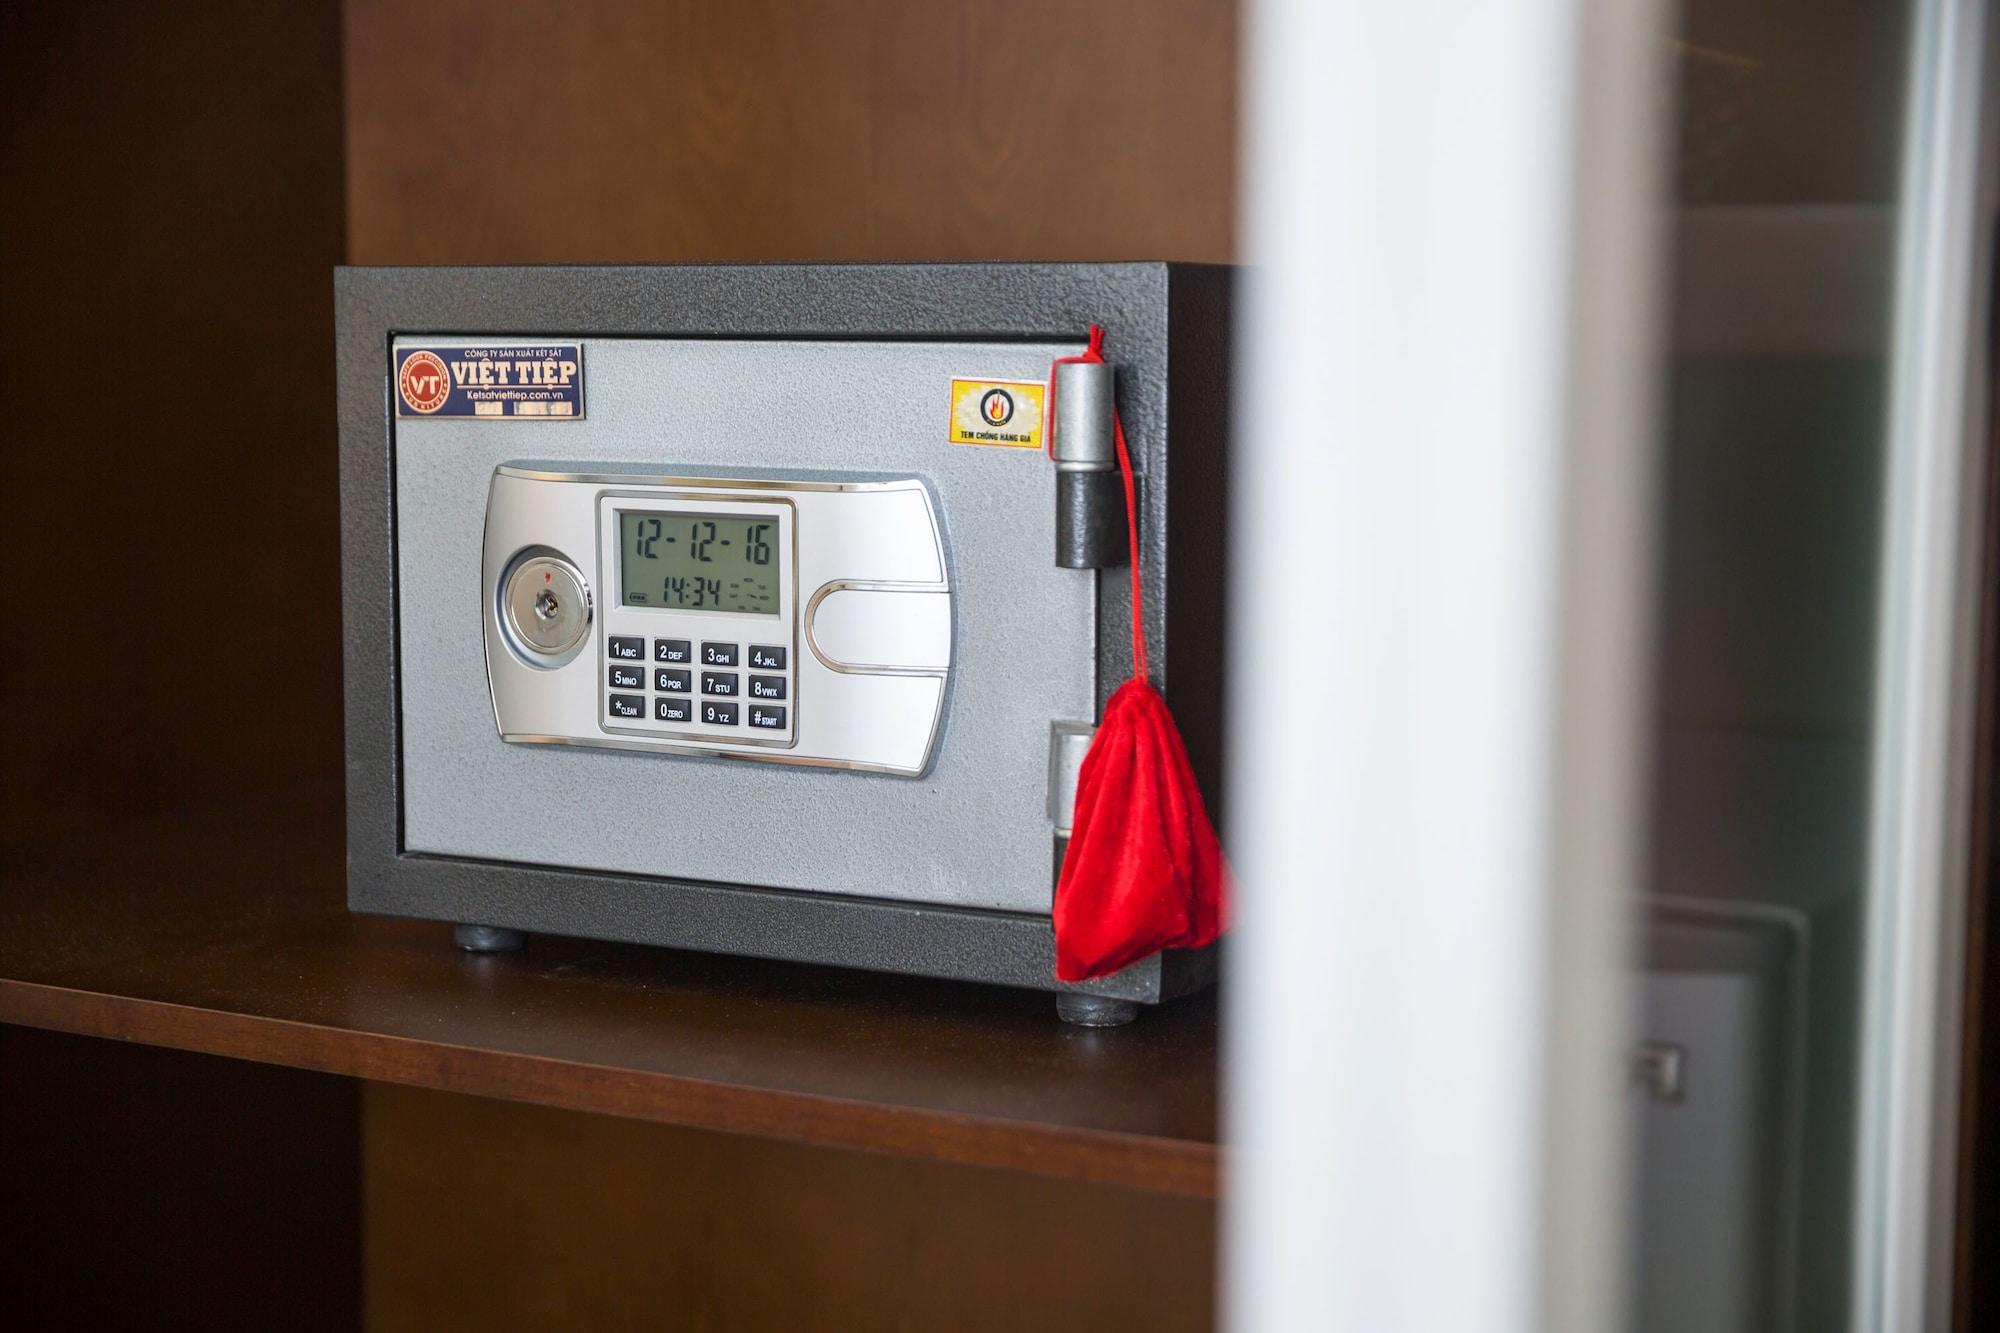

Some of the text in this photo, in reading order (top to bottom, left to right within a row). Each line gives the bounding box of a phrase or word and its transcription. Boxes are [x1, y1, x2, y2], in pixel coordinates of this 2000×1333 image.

[490, 349, 497, 358] TY
[410, 375, 439, 395] VT
[960, 431, 974, 439] TEM
[663, 576, 721, 606] 14:34
